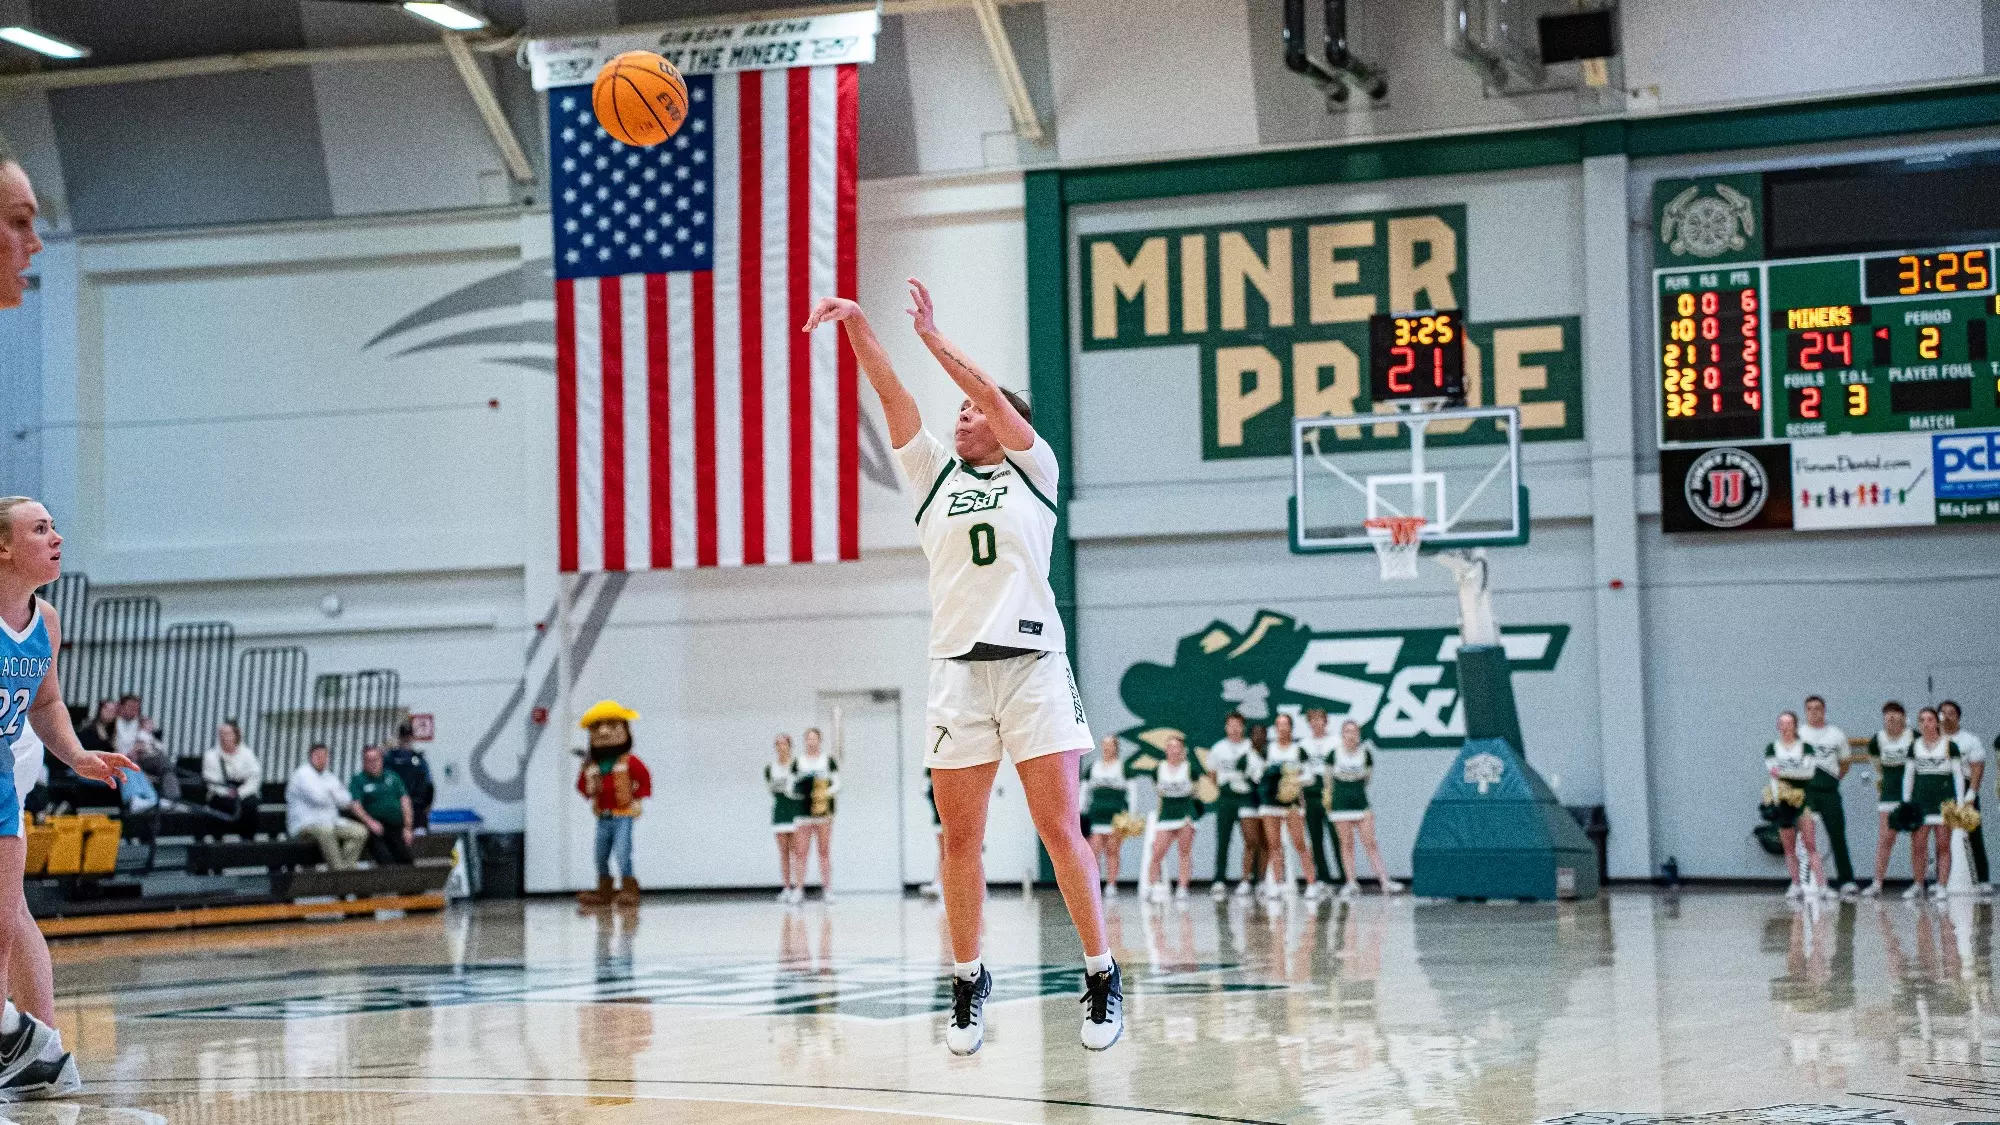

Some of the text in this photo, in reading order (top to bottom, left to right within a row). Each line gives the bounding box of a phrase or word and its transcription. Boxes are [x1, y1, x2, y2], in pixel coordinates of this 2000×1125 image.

[743, 20, 811, 37] ARENA
[687, 46, 722, 69] THE
[727, 40, 802, 67] MINERS
[1091, 216, 1458, 340] MINER
[1899, 251, 1988, 295] 3:25
[1678, 289, 1757, 317] 0 0 6
[1904, 309, 1952, 326] PERIOD
[1394, 315, 1454, 346] 3:25
[1671, 315, 1758, 341] 10 0 2
[1788, 306, 1852, 330] MINERS
[1664, 339, 1759, 368] 21 1 2
[1800, 331, 1852, 370] 24
[1920, 327, 1940, 359] 2
[1388, 345, 1443, 393] 21
[1664, 363, 1760, 393] 22 0 2
[1784, 372, 1825, 389] FOULS
[1888, 362, 1976, 382] PLAYER FOUL
[1215, 325, 1567, 448] PRDE
[1848, 384, 1868, 416] 3
[1666, 390, 1760, 417] 32 1 4
[1800, 386, 1821, 419] 2
[1785, 422, 1828, 438] SCORE
[1909, 415, 1955, 431] MATCH
[948, 486, 1008, 516] S&T
[1708, 470, 1744, 507] JJ
[1939, 502, 1983, 518] Major
[970, 523, 997, 566] 0
[0, 656, 52, 678] ACOCKS
[0, 687, 30, 736] 22
